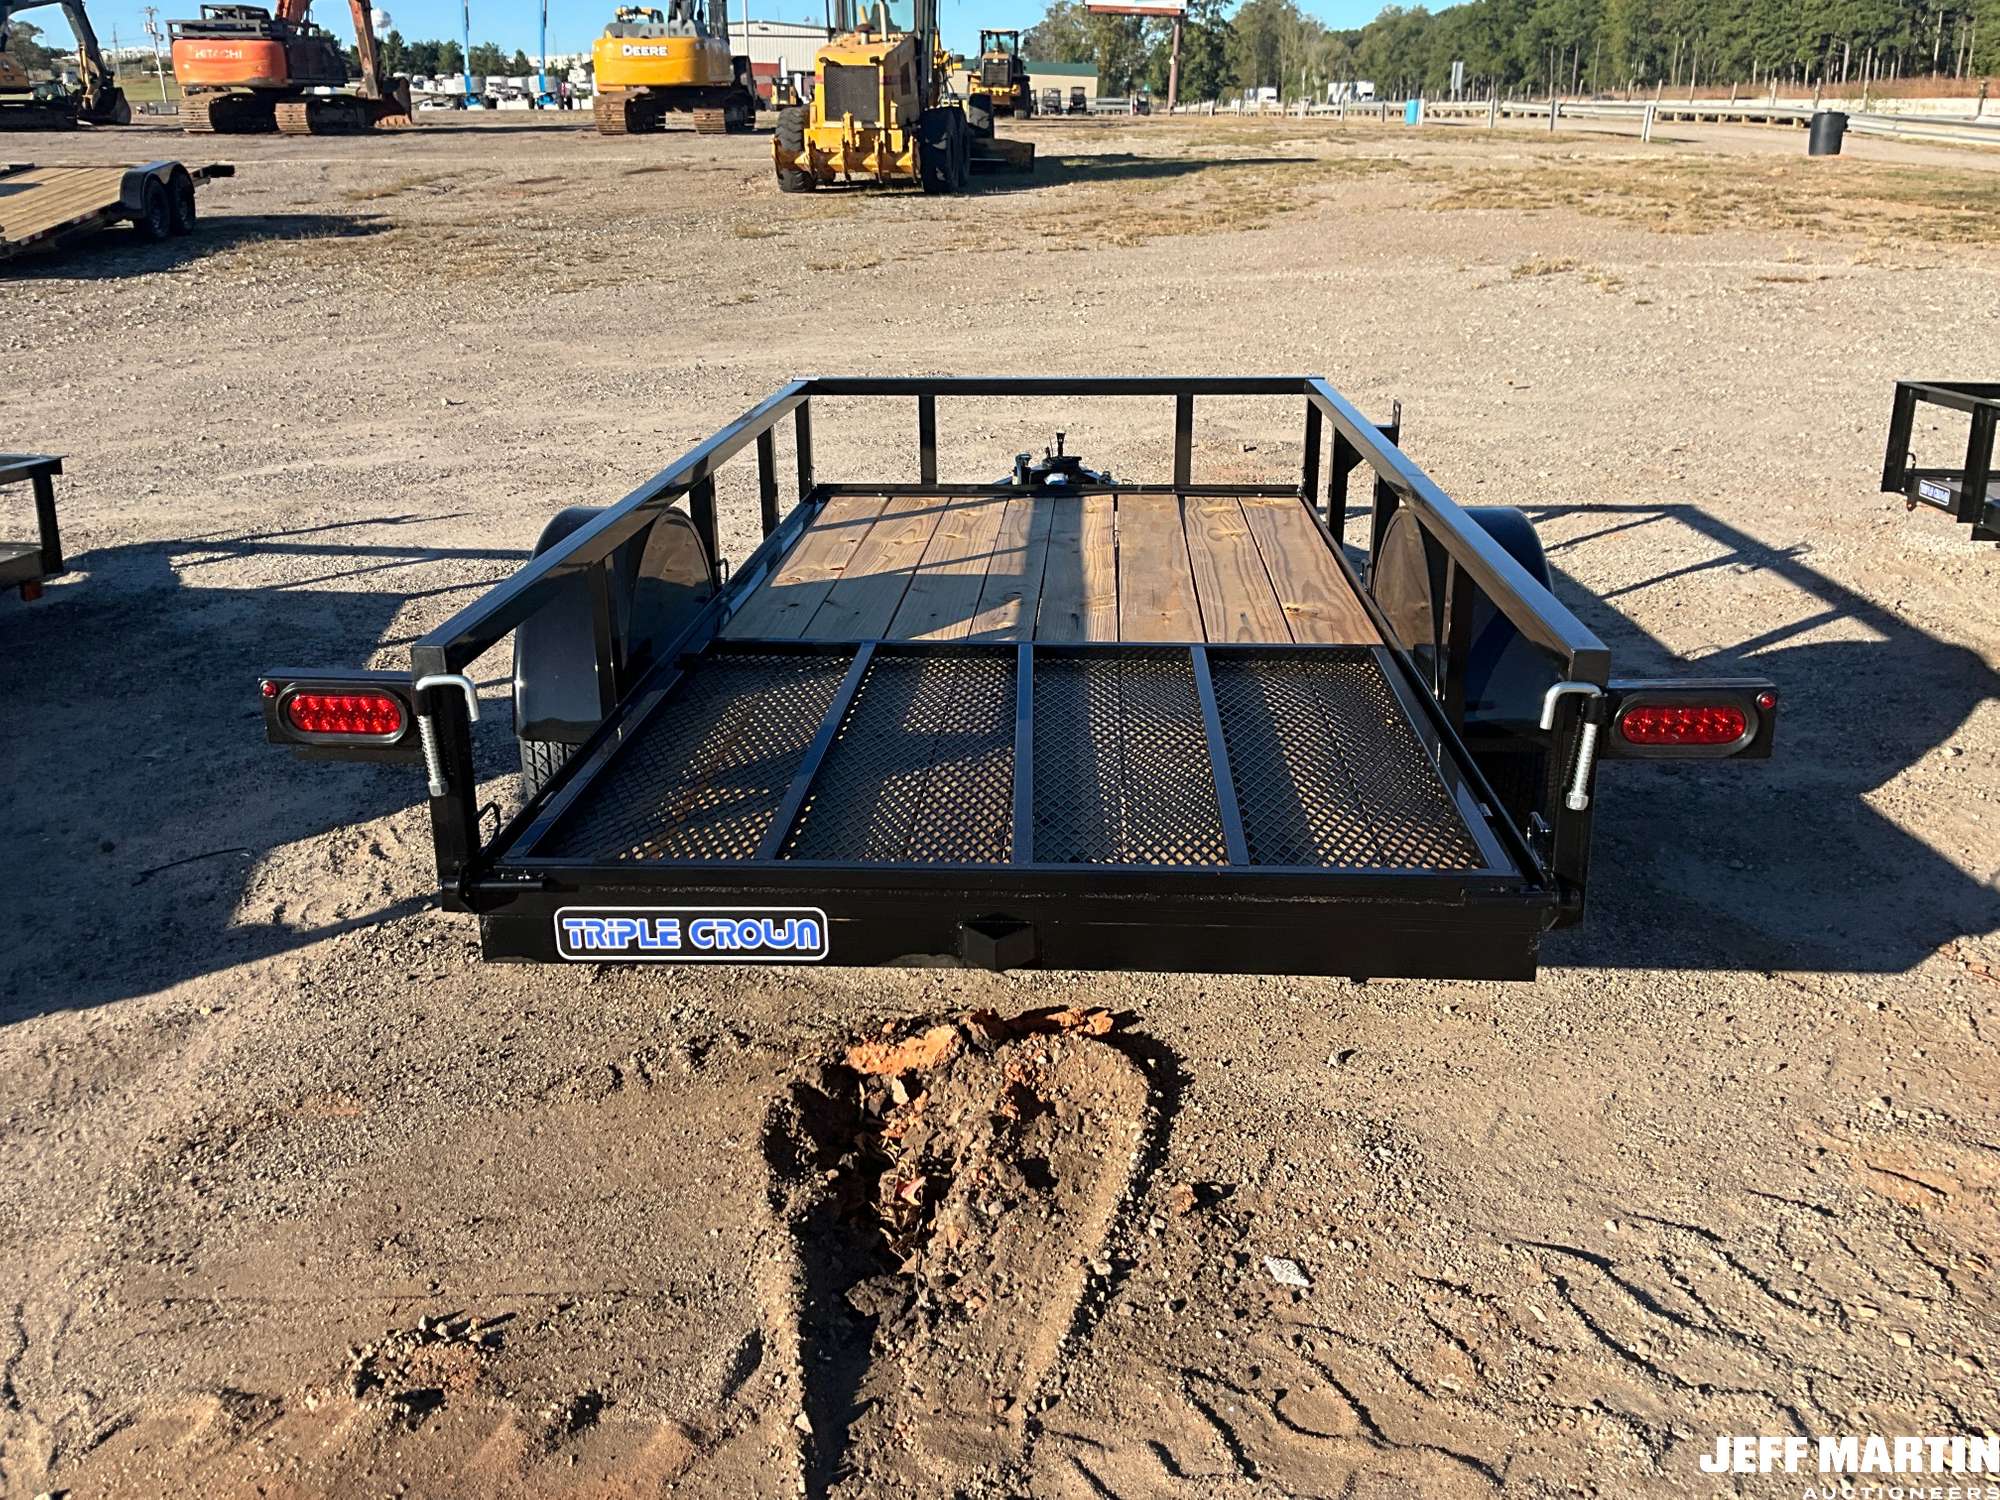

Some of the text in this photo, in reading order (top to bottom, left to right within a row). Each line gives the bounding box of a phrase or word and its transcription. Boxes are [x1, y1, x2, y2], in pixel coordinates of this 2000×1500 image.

[622, 45, 668, 56] DEERE
[563, 918, 821, 950] TRIPLE CROWN
